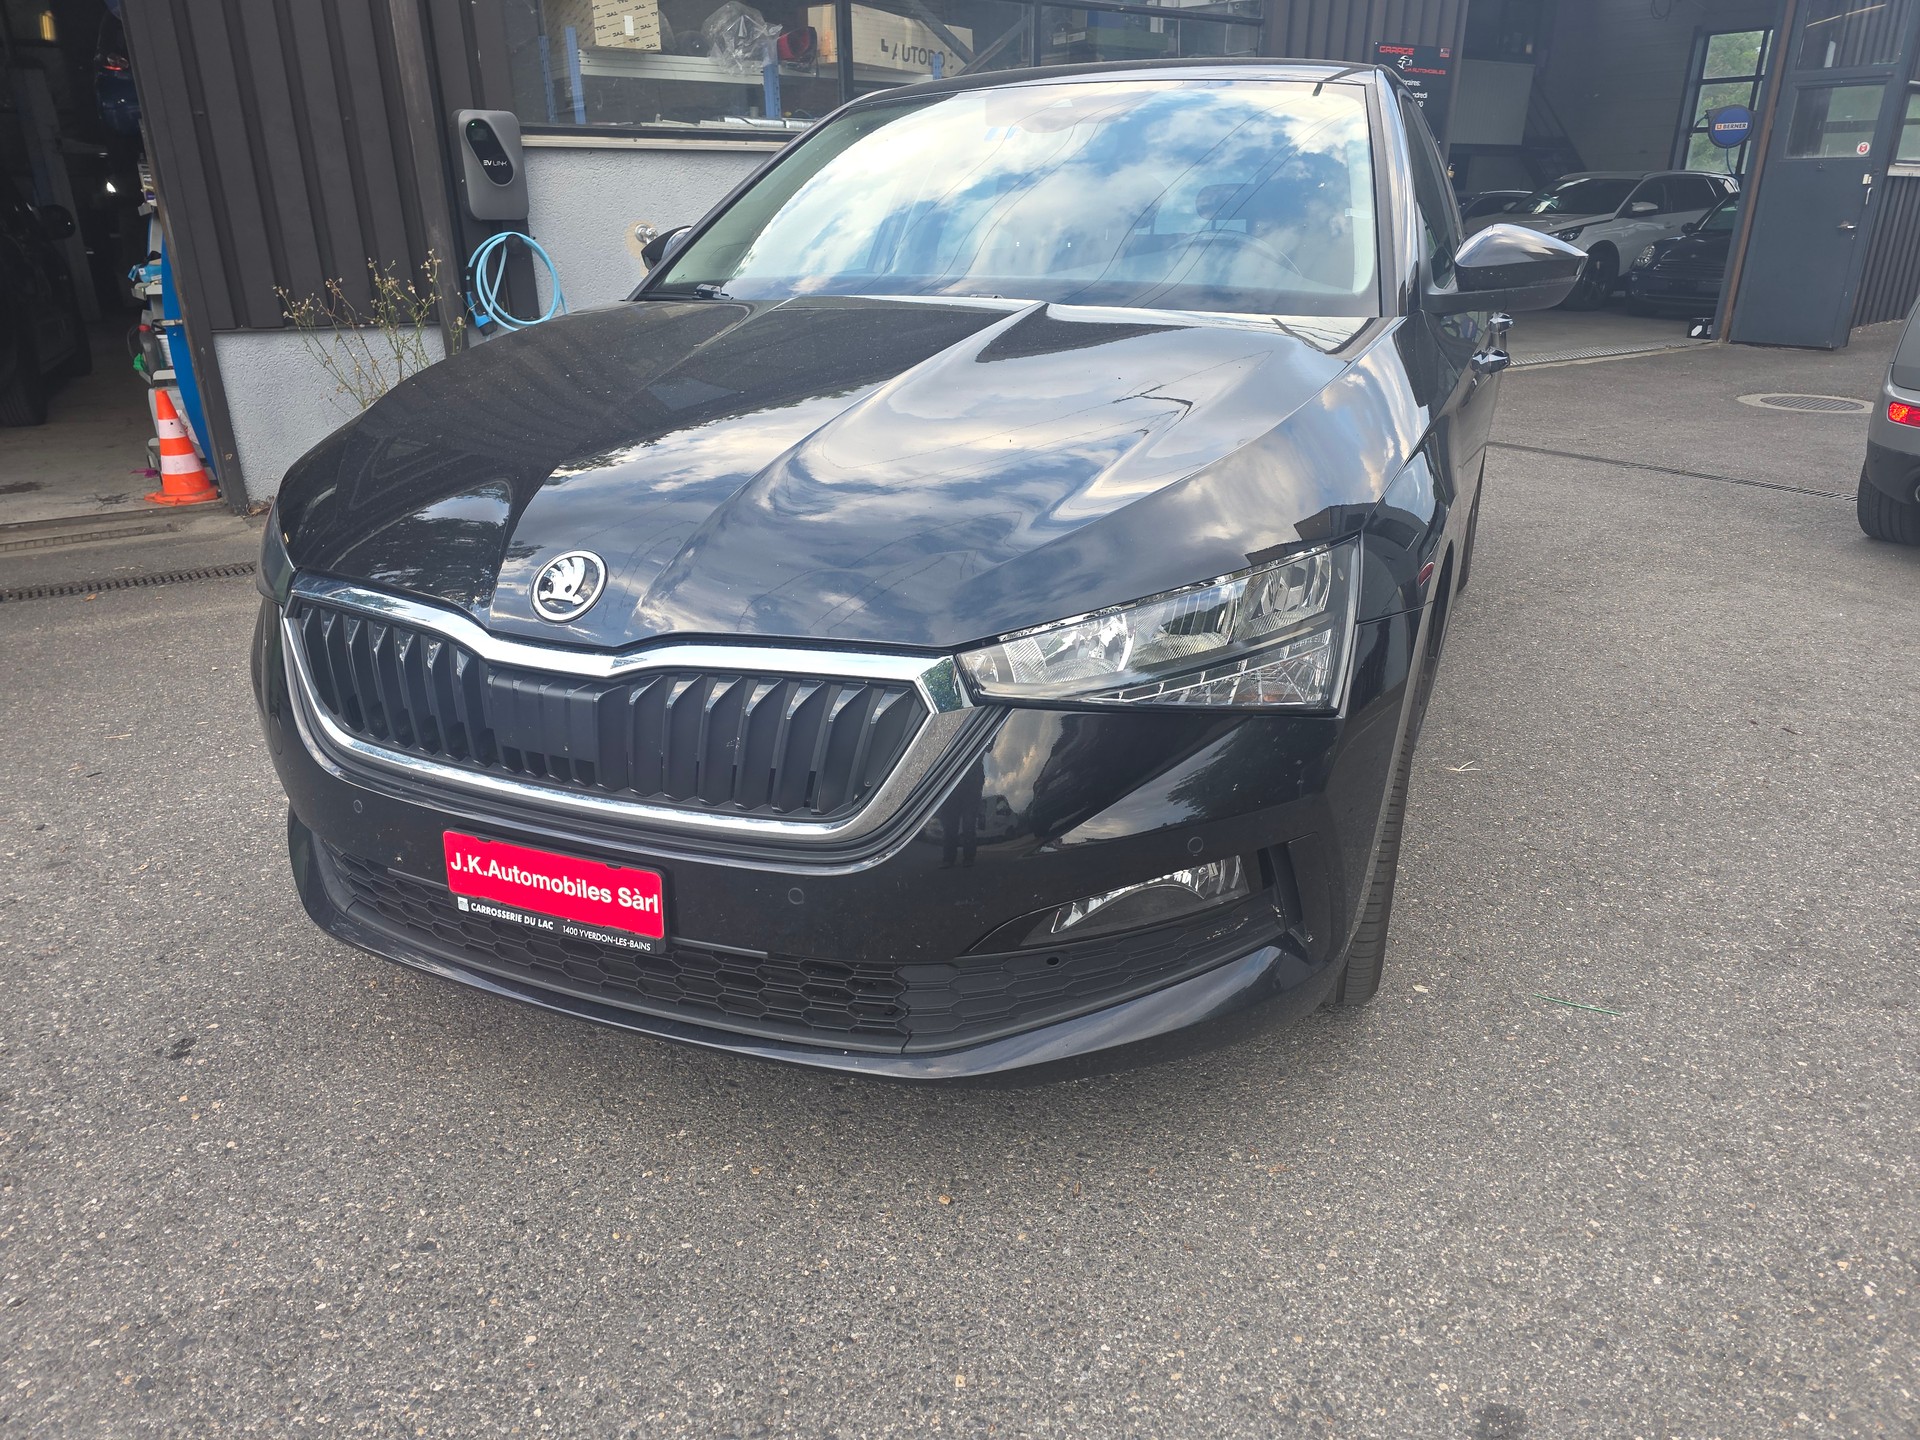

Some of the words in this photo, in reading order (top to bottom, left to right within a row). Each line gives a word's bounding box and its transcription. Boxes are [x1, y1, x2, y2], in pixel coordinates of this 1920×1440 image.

[1379, 45, 1415, 55] GARAGE
[450, 852, 612, 904] J.K.Automobiles
[617, 886, 659, 914] Sàrl
[470, 902, 522, 922] CARROSSERIE
[523, 915, 536, 926] DU
[537, 918, 554, 930] LAC
[562, 925, 578, 936] 1400
[579, 929, 651, 951] YVERDON-LES-BAINS
